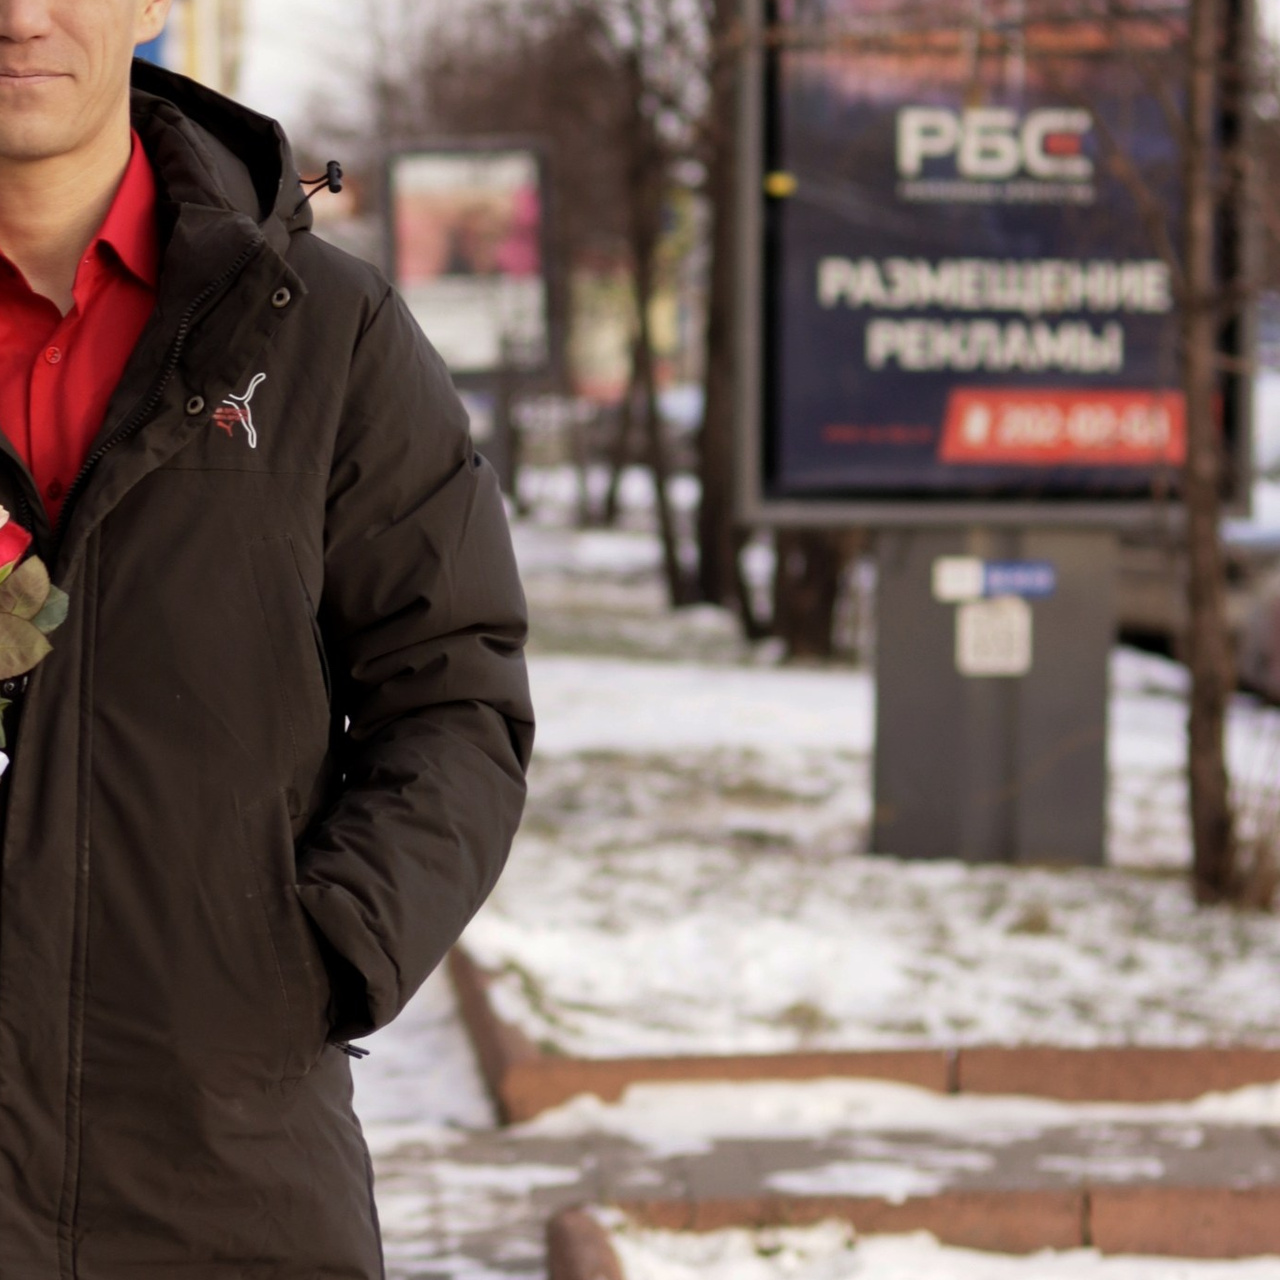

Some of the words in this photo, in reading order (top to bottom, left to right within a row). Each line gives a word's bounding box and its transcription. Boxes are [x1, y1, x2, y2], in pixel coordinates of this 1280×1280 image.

[897, 108, 1094, 179] РБС
[818, 258, 1171, 315] РАЗМЕЩЕНИЕ
[866, 319, 1123, 371] РЕКЛАМЫ
